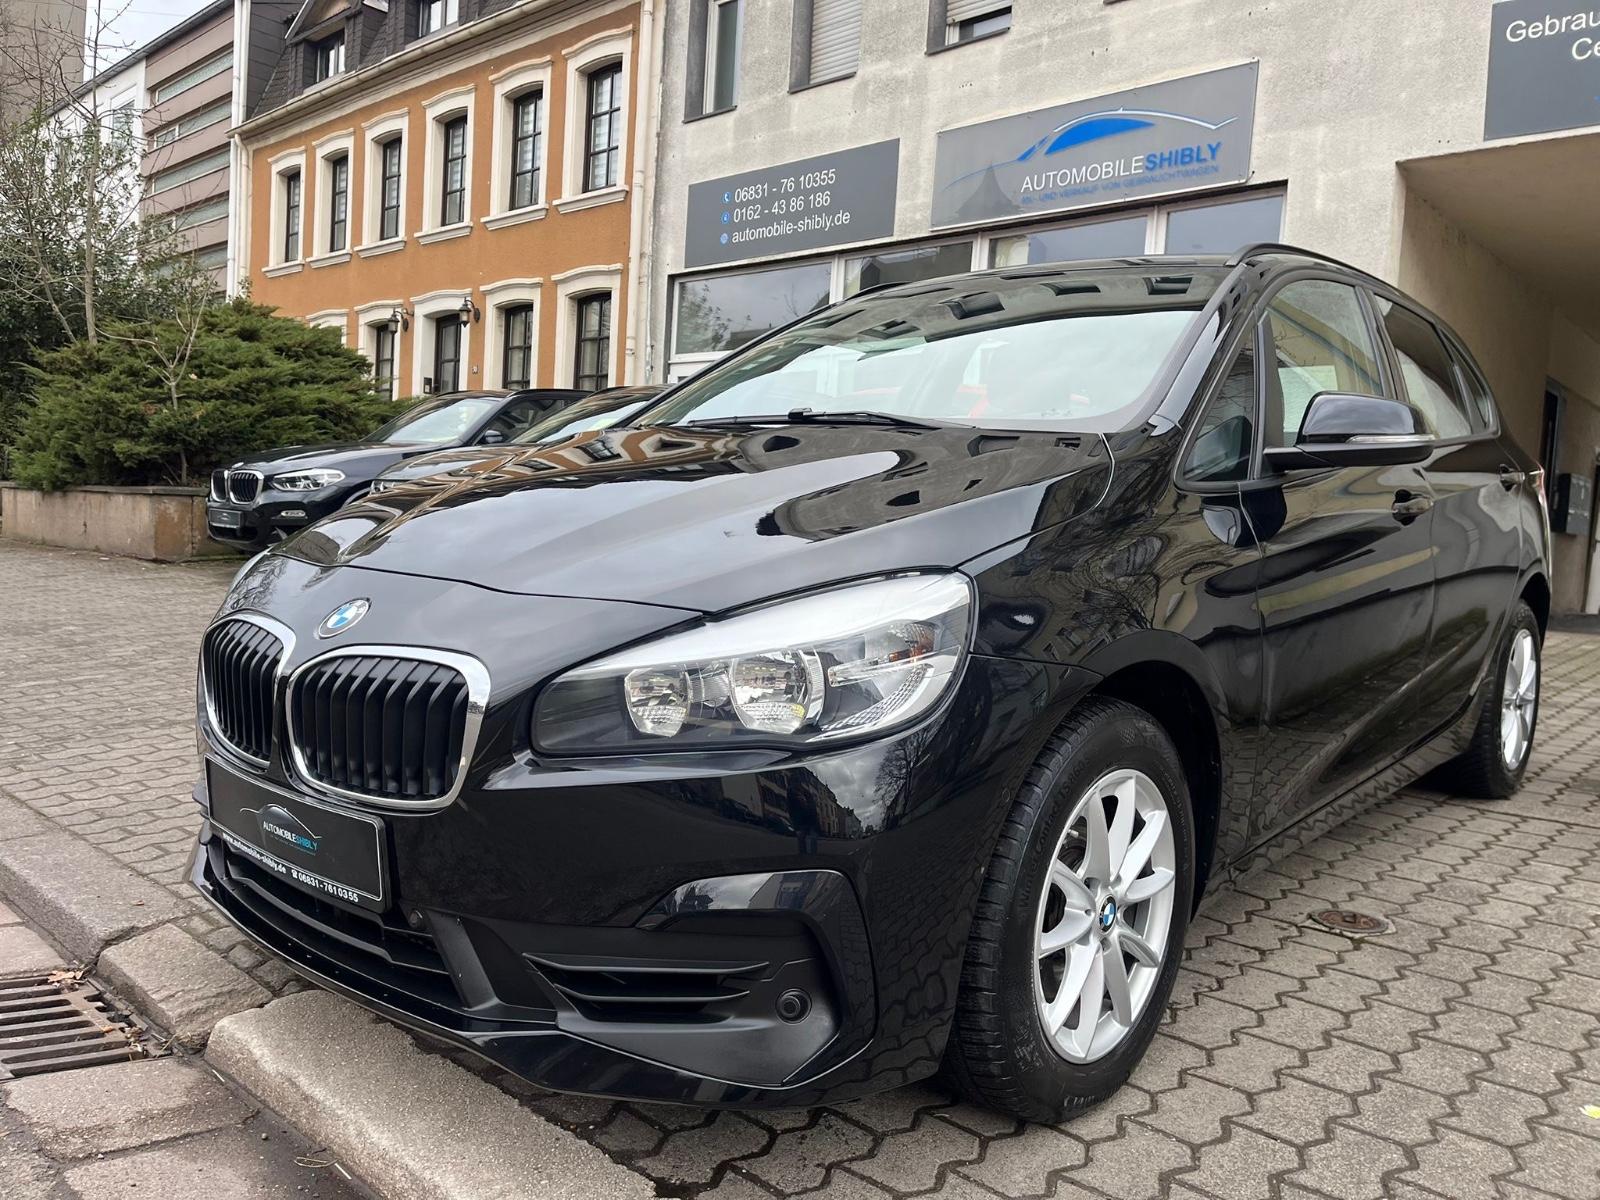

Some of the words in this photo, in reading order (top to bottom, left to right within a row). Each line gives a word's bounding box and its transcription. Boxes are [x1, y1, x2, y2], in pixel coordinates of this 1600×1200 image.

[734, 182, 768, 203] 06831
[781, 177, 795, 194] 76
[799, 168, 836, 190] 10355
[733, 204, 761, 223] 0162
[771, 200, 786, 216] 43
[789, 197, 804, 213] 86
[808, 191, 831, 209] 186
[732, 210, 851, 243] automobile-shibly.de
[298, 872, 359, 903] 06831-7610355
